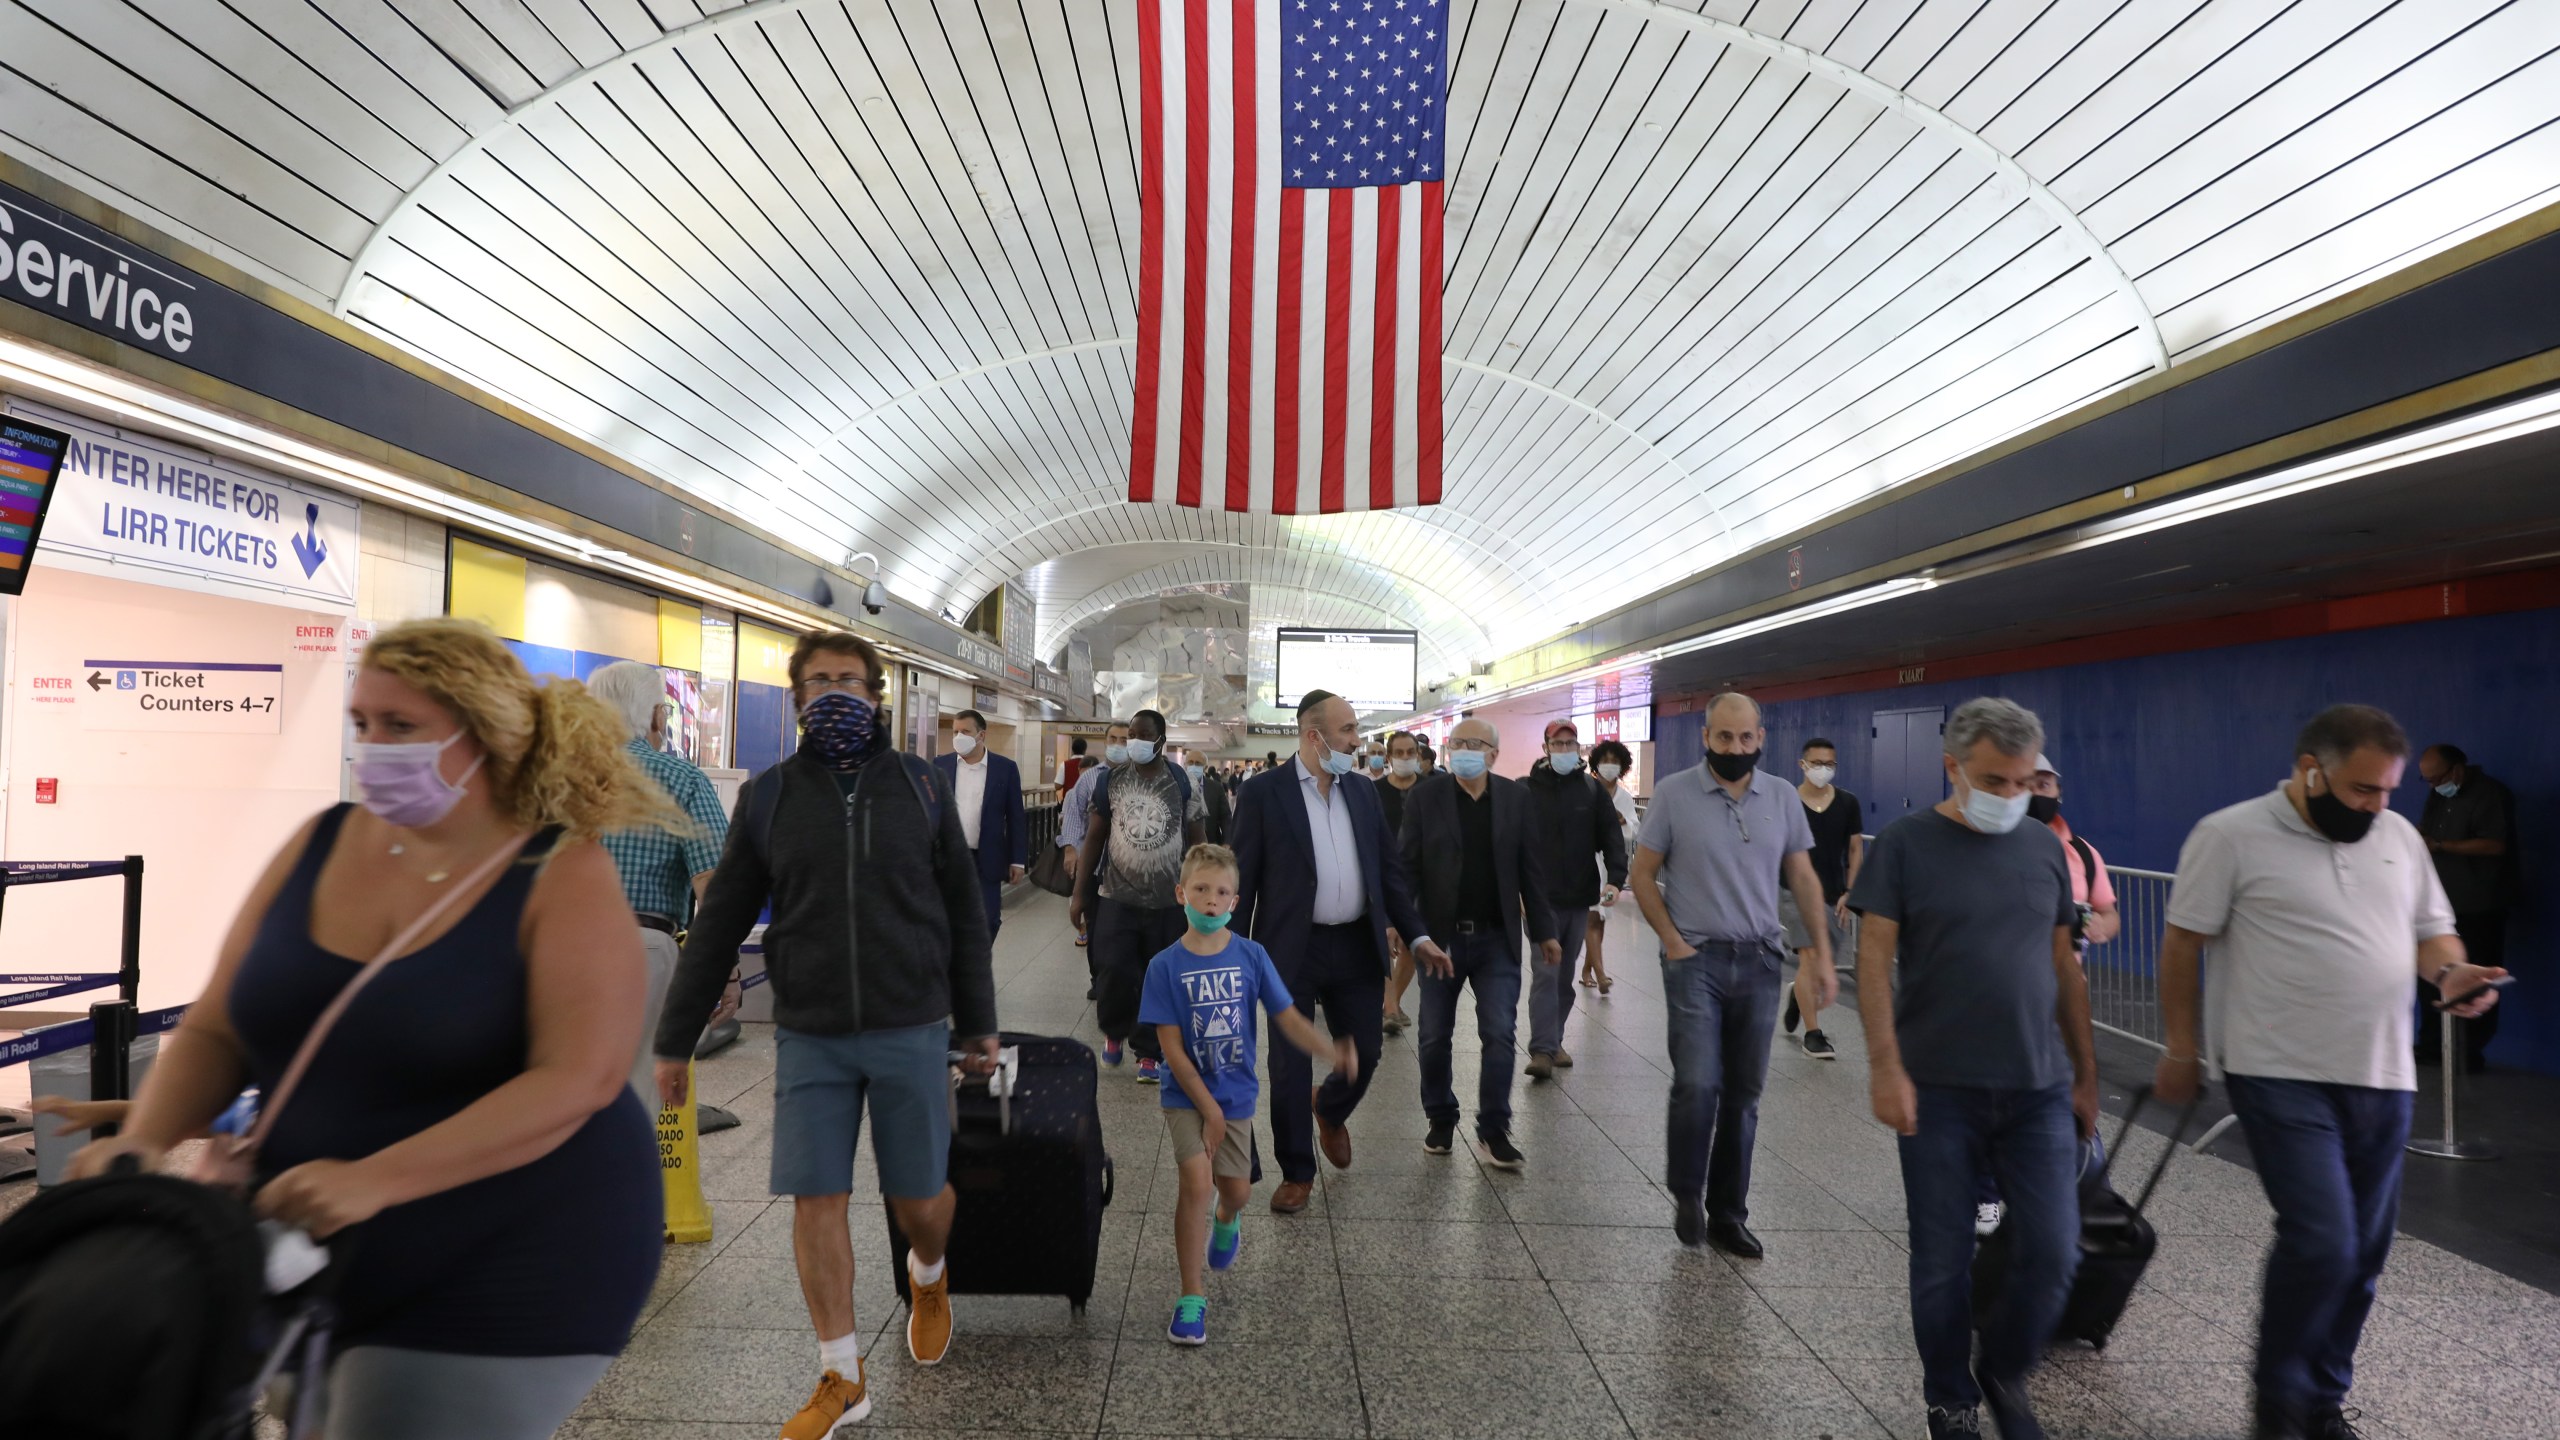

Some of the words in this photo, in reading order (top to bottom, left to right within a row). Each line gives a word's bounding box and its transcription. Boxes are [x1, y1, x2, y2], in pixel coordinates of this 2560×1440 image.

[4, 426, 58, 449] INFORMATION
[157, 464, 227, 510] HERE
[233, 484, 280, 524] FOR
[103, 502, 168, 547] LIRR
[174, 518, 278, 569] TICKETS
[296, 626, 334, 638] ENTER
[142, 670, 205, 689] Ticket
[1898, 667, 1926, 684] KMART
[33, 677, 72, 690] ENTER
[54, 696, 76, 704] PLEASE
[140, 694, 234, 713] Counters
[1261, 727, 1281, 735] Tracks
[11, 975, 28, 983] Long
[1182, 971, 1243, 1002] TAKE
[162, 1012, 183, 1024] Long
[11, 1039, 39, 1056] Road
[656, 1113, 678, 1125] OOR
[657, 1129, 684, 1141] DADO
[660, 1156, 682, 1168] ADO
